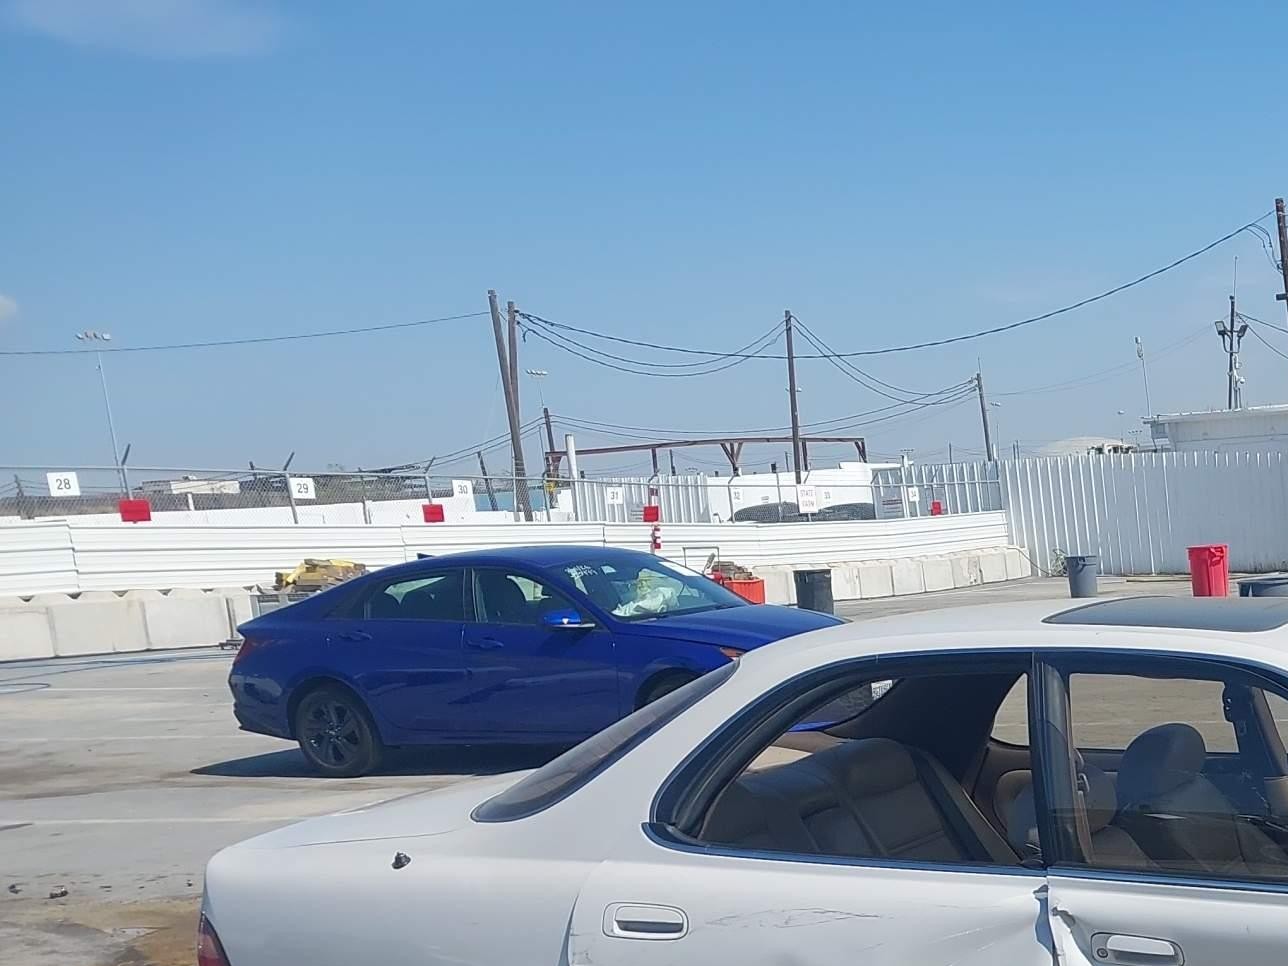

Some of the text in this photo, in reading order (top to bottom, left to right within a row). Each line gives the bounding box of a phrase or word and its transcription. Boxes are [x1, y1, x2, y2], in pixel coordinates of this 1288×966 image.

[55, 478, 72, 490] 28
[296, 482, 309, 494] 29
[457, 484, 469, 495] 30
[610, 491, 619, 500] 31
